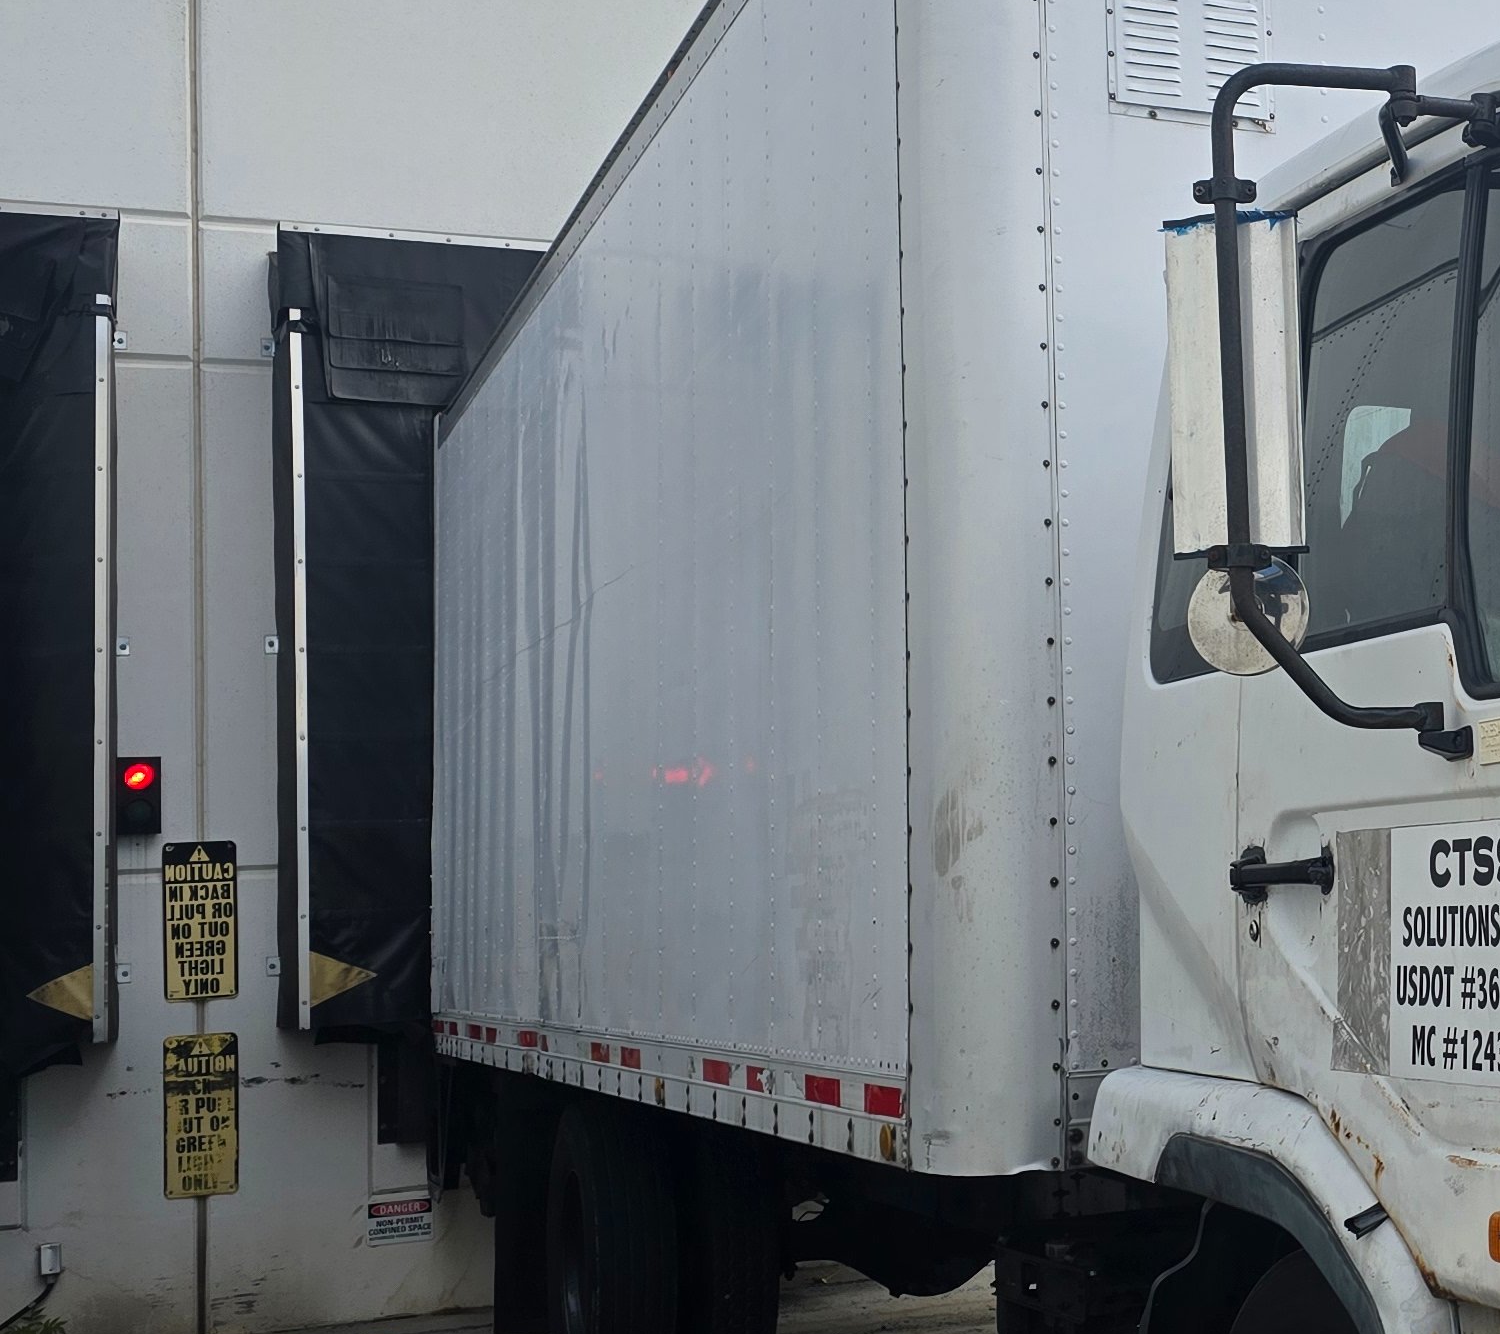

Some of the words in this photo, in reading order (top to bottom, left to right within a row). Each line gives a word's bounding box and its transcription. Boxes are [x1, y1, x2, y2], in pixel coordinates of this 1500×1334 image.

[1402, 903, 1500, 948] SOLUTIONS
[1396, 965, 1454, 1008] USDOT
[1411, 1025, 1437, 1068] MC
[177, 1054, 235, 1075] AUTION
[177, 1116, 204, 1134] UT
[379, 1201, 421, 1215] DANGER
[368, 1225, 407, 1236] CONFINED
[408, 1223, 432, 1232] SPACE
[376, 1216, 424, 1227] NON-PERMIT
